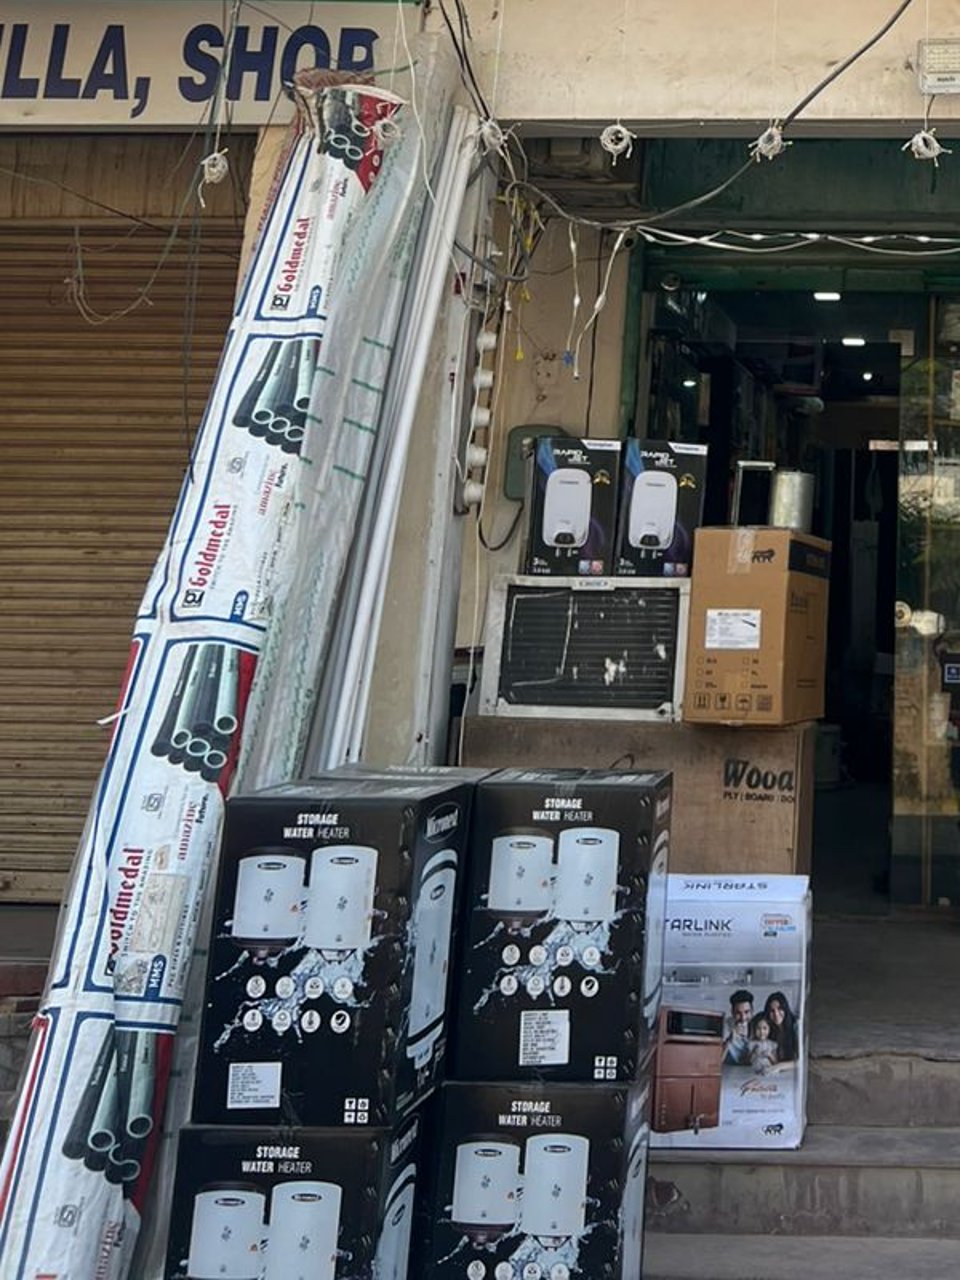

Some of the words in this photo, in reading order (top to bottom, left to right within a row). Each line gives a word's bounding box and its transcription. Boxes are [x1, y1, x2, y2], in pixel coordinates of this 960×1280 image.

[0, 23, 152, 118] LLA,
[189, 504, 232, 588] Goldmedal
[544, 797, 582, 809] STORAGE
[298, 813, 338, 826] STORAGE
[532, 810, 560, 821] WATER
[564, 810, 593, 822] HEATER
[284, 827, 314, 839] WATER
[317, 827, 350, 839] HEATER
[149, 959, 164, 988] MMS
[511, 1101, 551, 1114] STORAGE
[498, 1114, 529, 1127] WATER
[531, 1115, 562, 1127] HEATER
[256, 1146, 300, 1159] STORAGE
[242, 1161, 274, 1173] WATER
[277, 1161, 312, 1174] HEATER
